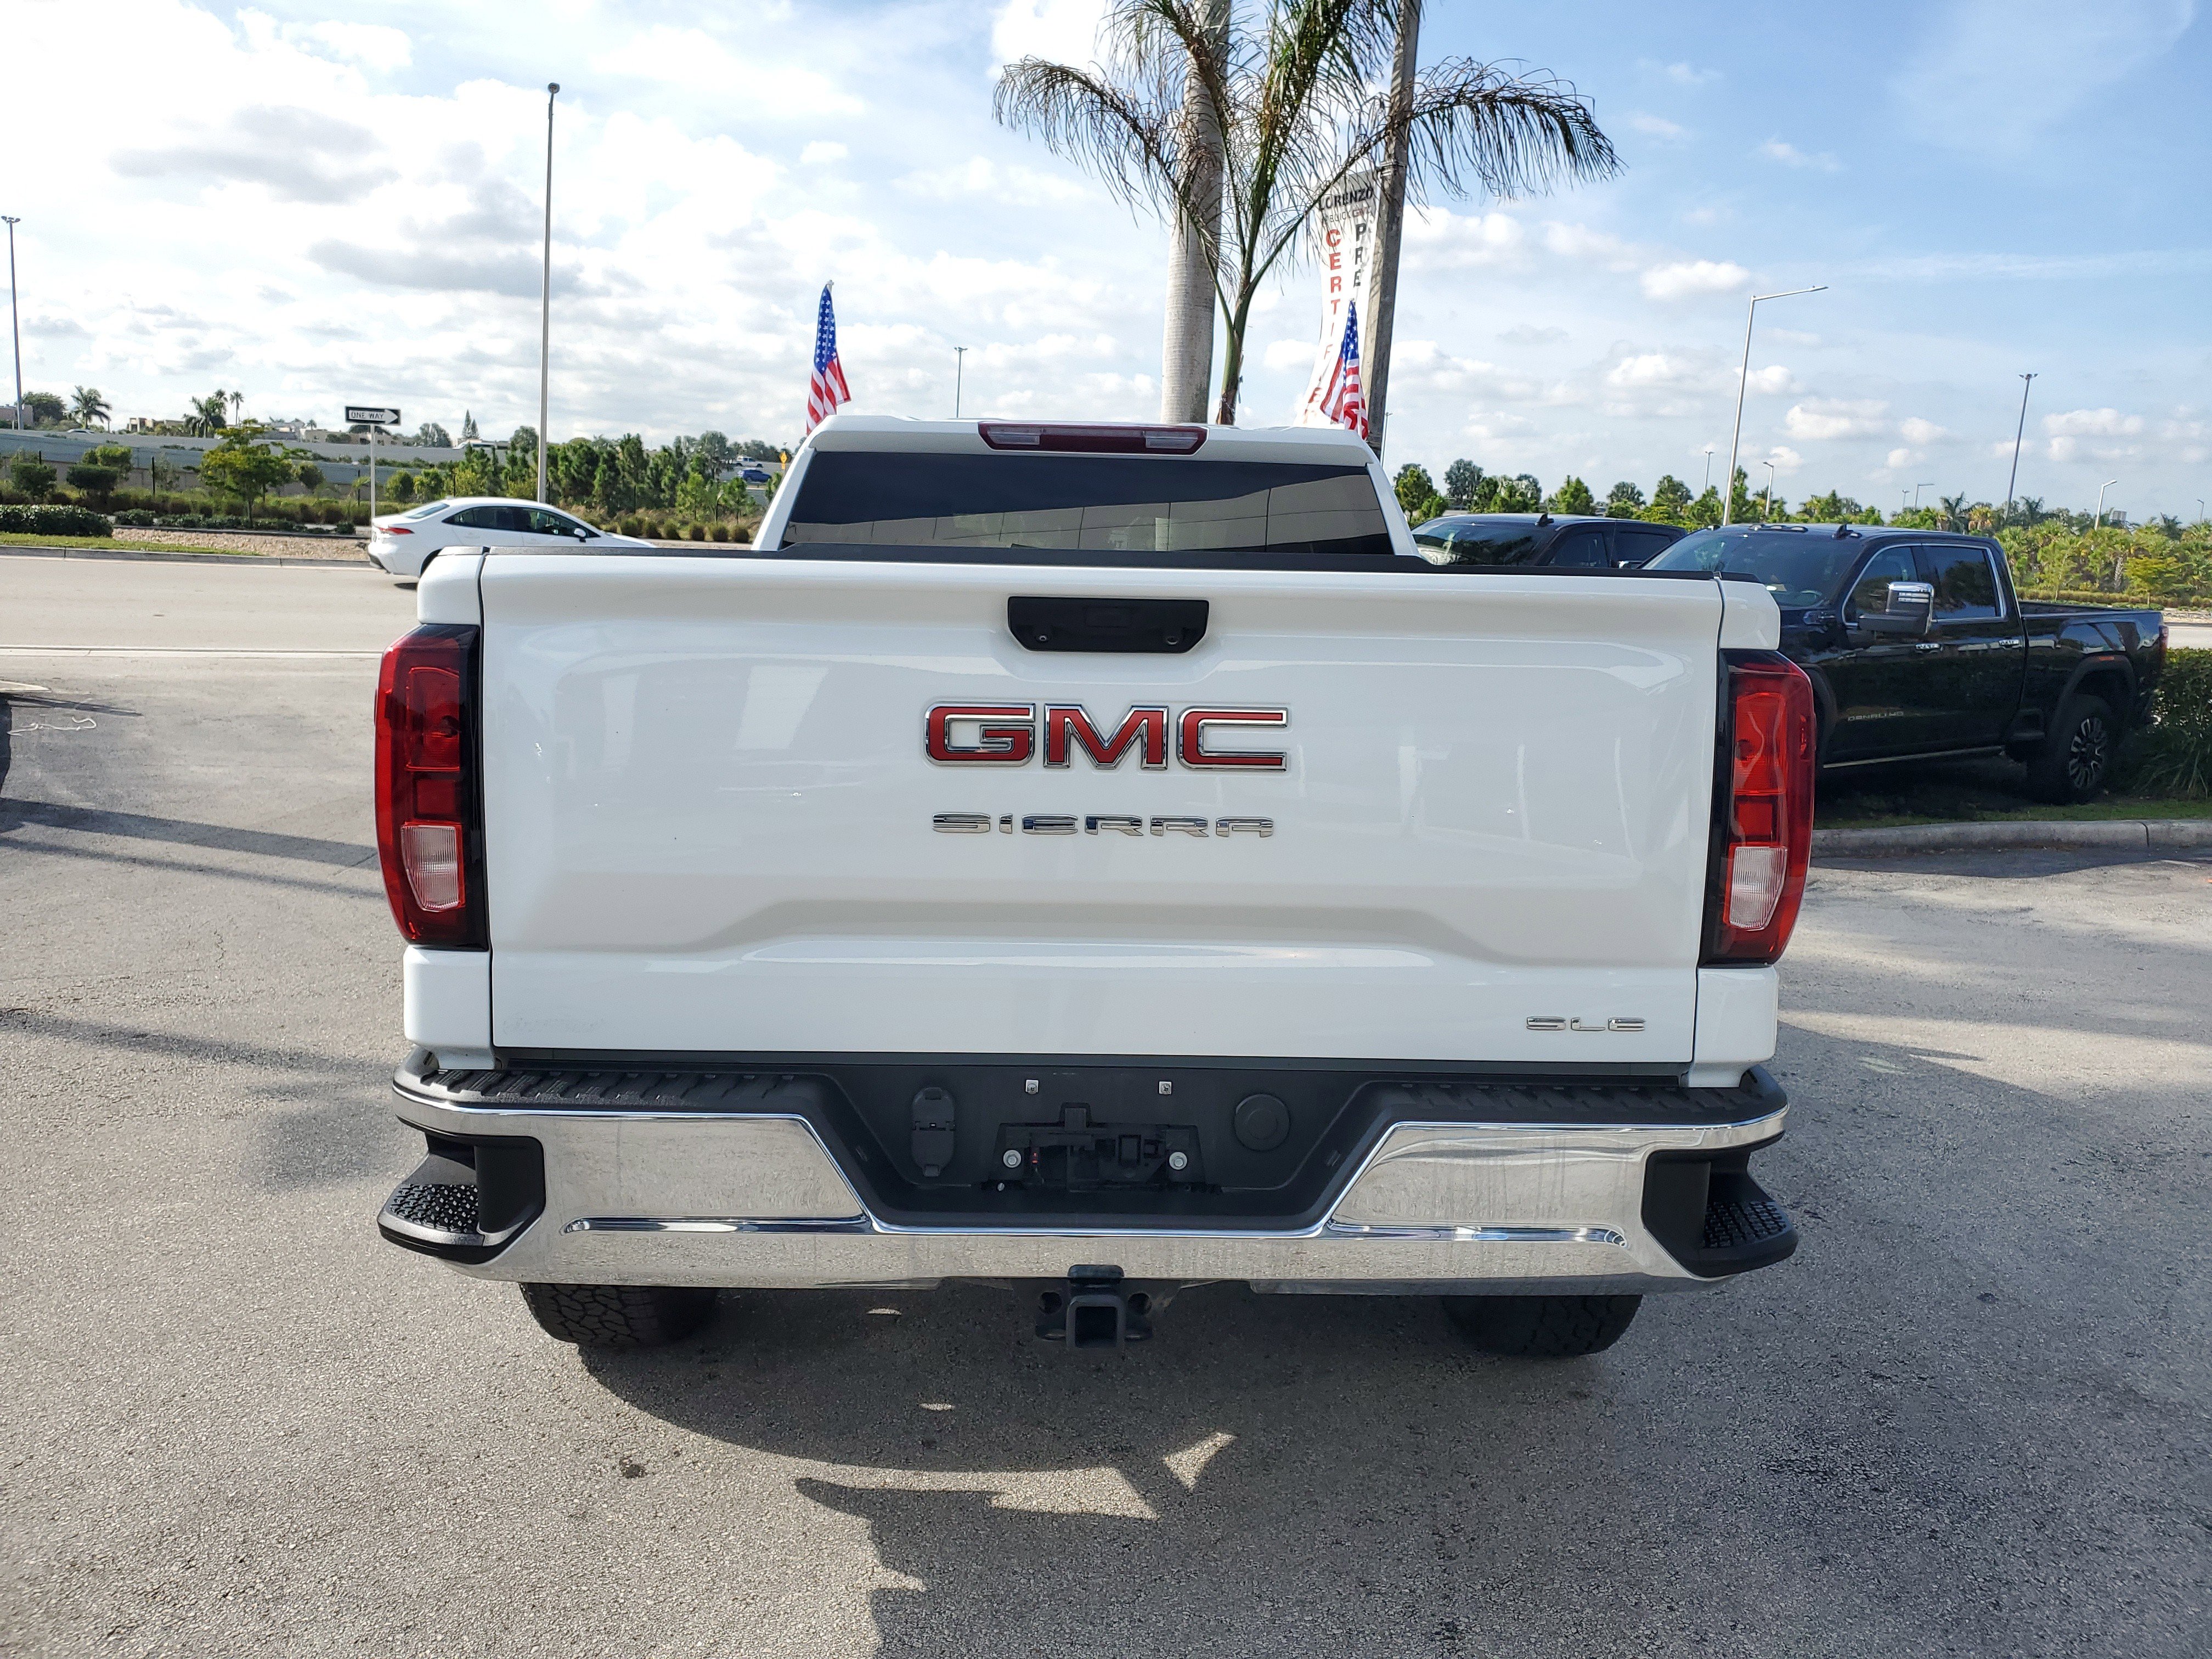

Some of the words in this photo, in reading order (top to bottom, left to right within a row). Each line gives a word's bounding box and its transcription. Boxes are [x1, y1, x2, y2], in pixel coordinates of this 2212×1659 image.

[924, 702, 1289, 771] GMC
[932, 812, 1274, 838] SIERRA
[1526, 1016, 1646, 1031] SLE
